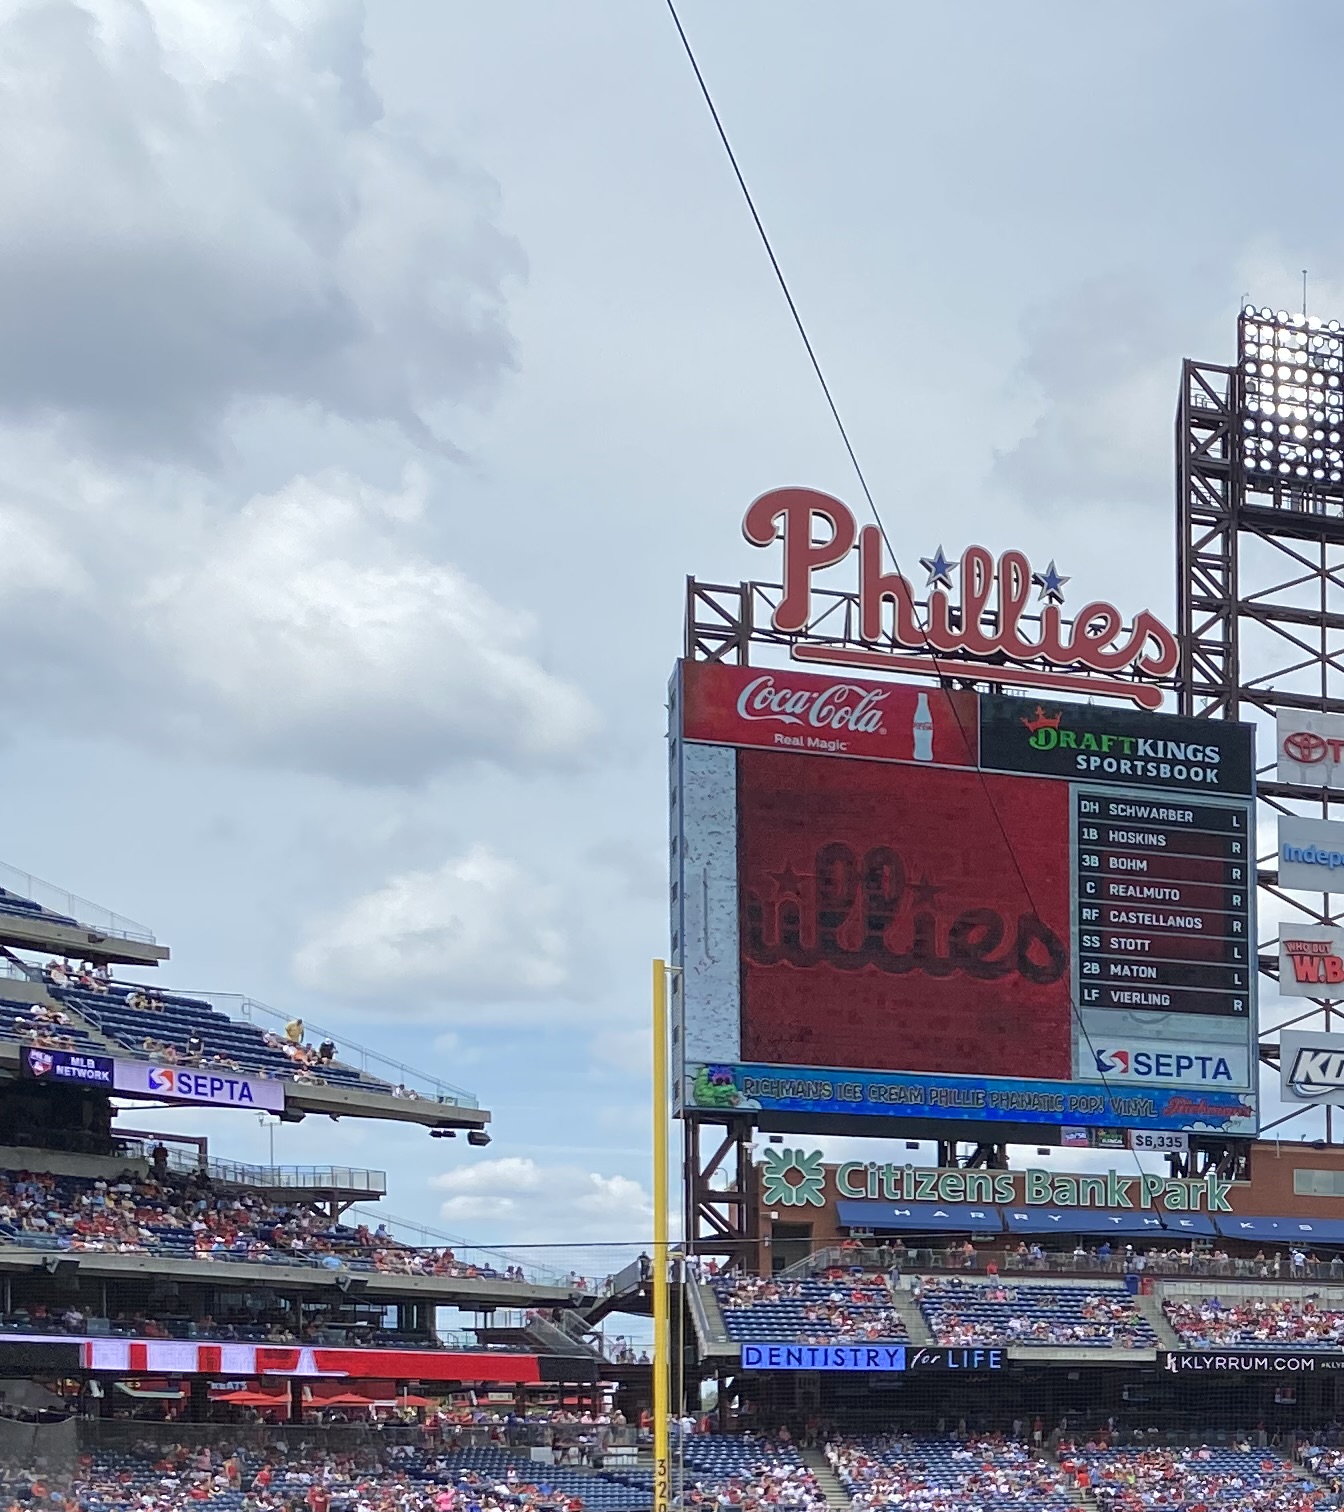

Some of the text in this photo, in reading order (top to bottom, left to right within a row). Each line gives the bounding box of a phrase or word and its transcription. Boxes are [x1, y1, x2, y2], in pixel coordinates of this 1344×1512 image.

[742, 486, 1180, 678] Phillies
[737, 675, 891, 734] Coca-Cola
[774, 733, 847, 752] Real Magic
[1029, 727, 1221, 763] DRAFTKINGS
[1076, 755, 1219, 783] SPORTSBOOK
[1081, 801, 1240, 827] DH SCHWARBER L
[1082, 828, 1240, 854] 1B HOSKINS R
[1082, 855, 1241, 880] 3B BOHM R
[1086, 883, 1241, 906] C REALMUTO R
[1082, 909, 1242, 932] RF CASTELLANOS R
[1082, 936, 1241, 959] SS STOTT L
[1083, 962, 1242, 984] 2B MATON L
[1084, 989, 1242, 1011] LF VIERLING R
[56, 1065, 110, 1081] NETWORK
[70, 1056, 95, 1069] MLB
[1134, 1053, 1232, 1081] SEPTA
[177, 1073, 254, 1102] SEPTA
[837, 1083, 862, 1101] ICE
[868, 1085, 923, 1105] CREAM
[929, 1087, 985, 1108] PHILLIE
[989, 1090, 1064, 1112] PHANATIC
[1111, 1097, 1158, 1118] VINYL
[1136, 1133, 1183, 1148] $6,335
[835, 1161, 1234, 1212] Citizens Bank Park
[745, 1347, 1002, 1369] DENTISTRY for LIFE
[1181, 1355, 1315, 1371] KLYRRUM.COM
